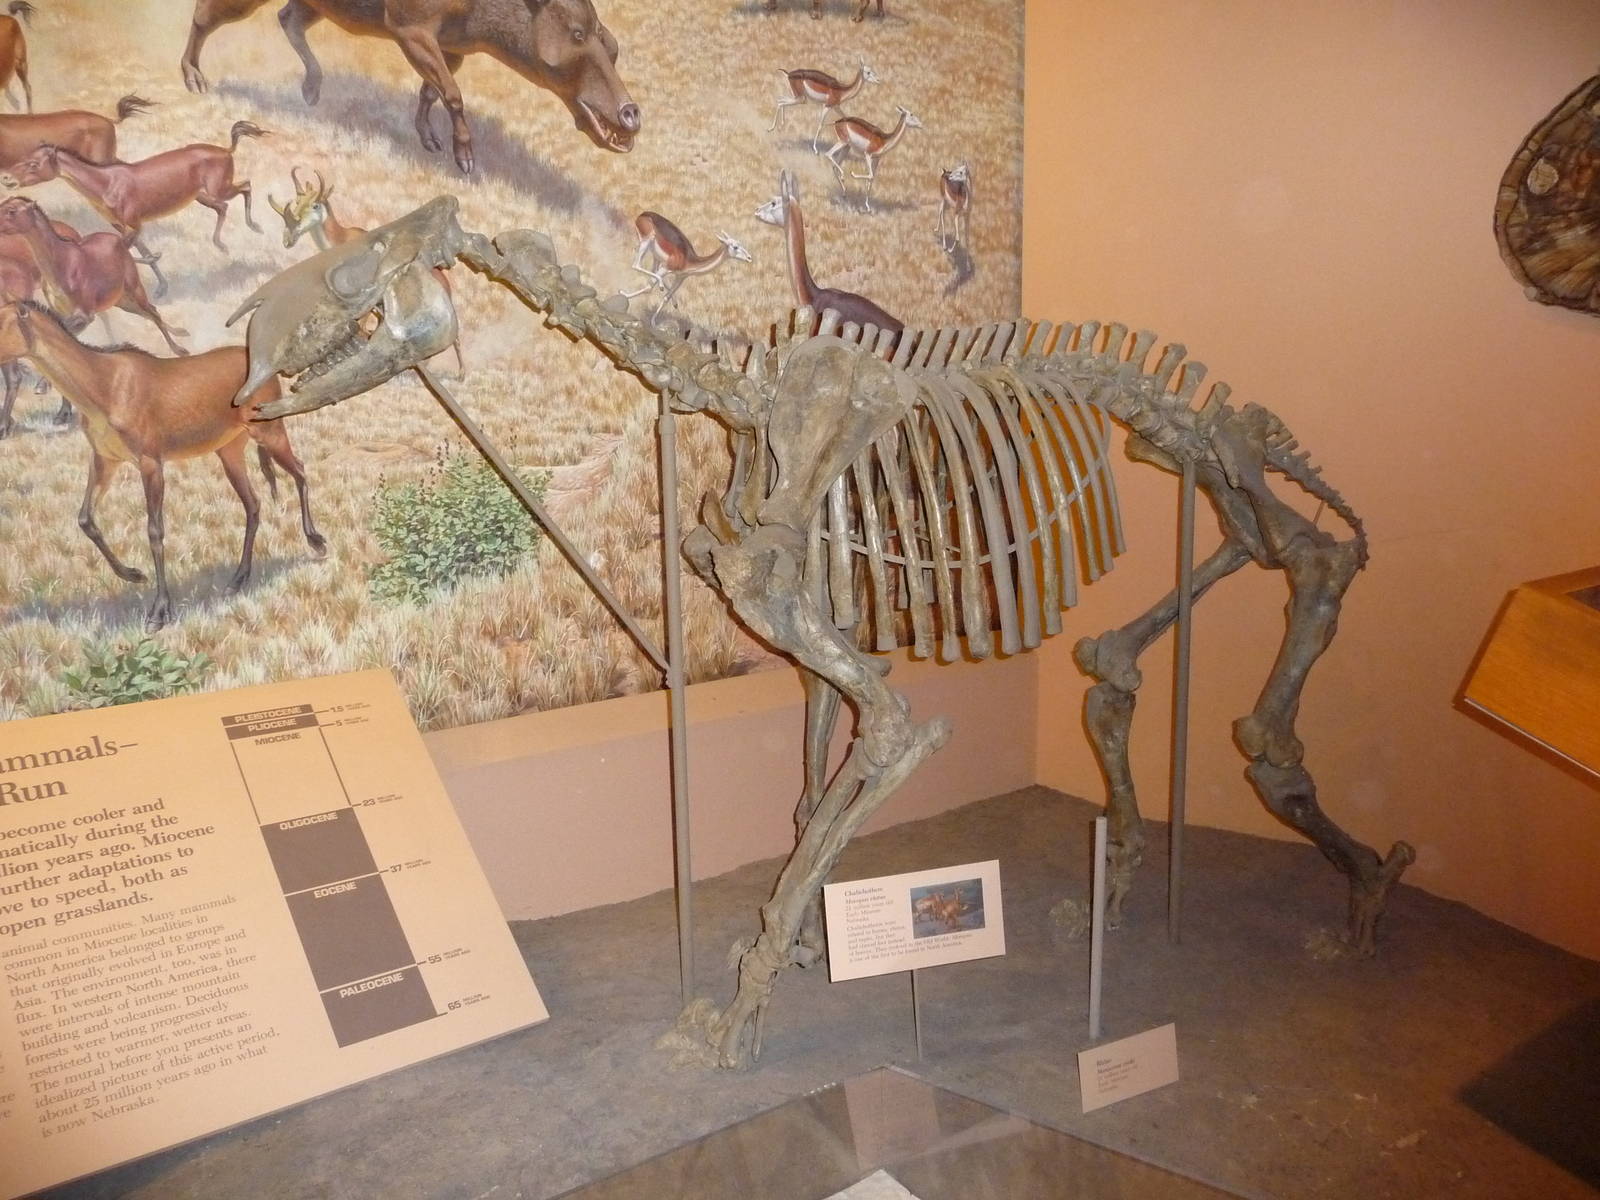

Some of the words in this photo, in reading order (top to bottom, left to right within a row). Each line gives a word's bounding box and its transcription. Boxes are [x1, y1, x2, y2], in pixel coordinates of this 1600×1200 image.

[235, 707, 302, 723] PLEISTOCENE
[249, 719, 296, 732] PLIOCENE
[255, 733, 301, 745] MIOCENE
[0, 780, 68, 806] Run
[73, 808, 126, 826] cooler
[133, 798, 165, 815] and
[86, 824, 145, 841] during
[151, 815, 178, 828] the
[280, 812, 338, 830] OLIGOCENE
[0, 863, 39, 877] lion
[46, 850, 93, 871] years
[100, 844, 136, 857] ago.
[142, 824, 215, 847] Miocene
[68, 852, 172, 882] adaptations
[178, 848, 194, 857] to
[390, 865, 401, 873] 37
[31, 896, 49, 907] to
[56, 880, 116, 905] speed,
[123, 869, 164, 888] both
[170, 866, 188, 876] as
[314, 882, 357, 899] EOCENE
[0, 917, 46, 936] open
[54, 892, 153, 925] grasslands.
[1, 939, 48, 958] animal
[53, 921, 136, 945] communities.
[142, 910, 175, 923] Many
[181, 895, 236, 914] mammals
[4, 952, 63, 970] common
[68, 947, 79, 956] in
[84, 933, 137, 951] Miocene
[141, 920, 194, 938] localities
[197, 914, 208, 924] in
[7, 967, 46, 983] North
[52, 954, 105, 973] America
[110, 937, 166, 957] belonged
[170, 932, 181, 942] to
[186, 923, 225, 941] groups
[10, 982, 43, 996] that
[42, 966, 104, 989] originally
[109, 952, 157, 971] evolved
[161, 951, 173, 961] in
[177, 938, 222, 958] Europe
[224, 929, 246, 941] and
[428, 954, 442, 964] 55
[14, 996, 46, 1011] Asia.
[52, 987, 78, 1001] The
[200, 950, 222, 960] was
[225, 946, 237, 955] in
[16, 1009, 46, 1024] flux.
[52, 1004, 67, 1015] In
[72, 989, 122, 1007] western
[126, 980, 163, 994] North
[227, 953, 256, 968] there
[340, 973, 404, 998] PALEOCENE
[19, 1025, 51, 1038] were
[58, 1005, 113, 1027] intervals
[117, 999, 130, 1011] of
[135, 988, 178, 1006] intense
[182, 971, 240, 993] mountain
[22, 1029, 80, 1050] building
[84, 1021, 109, 1035] and
[114, 1002, 181, 1026] volcanism.
[185, 982, 249, 1006] Deciduous
[448, 1001, 461, 1010] 65
[24, 1046, 68, 1066] forests
[74, 1037, 106, 1049] were
[111, 1024, 147, 1042] being
[151, 1000, 229, 1031] progressively
[28, 1054, 92, 1080] restricted
[97, 1049, 110, 1059] to
[173, 1022, 211, 1037] wetter
[216, 1011, 251, 1024] areas.
[31, 1080, 59, 1094] The
[65, 1066, 105, 1085] mural
[110, 1052, 151, 1069] before
[156, 1044, 180, 1060] you
[184, 1027, 233, 1049] presents
[237, 1024, 252, 1033] an
[35, 1083, 97, 1108] idealized
[101, 1068, 149, 1091] picture
[153, 1061, 165, 1073] of
[169, 1053, 193, 1066] this
[197, 1043, 233, 1059] active
[39, 1105, 78, 1123] about
[84, 1097, 100, 1109] 25
[105, 1082, 152, 1103] million
[156, 1072, 190, 1090] years
[194, 1063, 216, 1076] ago
[220, 1056, 232, 1067] in
[236, 1046, 267, 1061] what
[42, 1127, 53, 1137] is
[56, 1118, 86, 1133] now
[92, 1099, 160, 1121] Nebraska.
